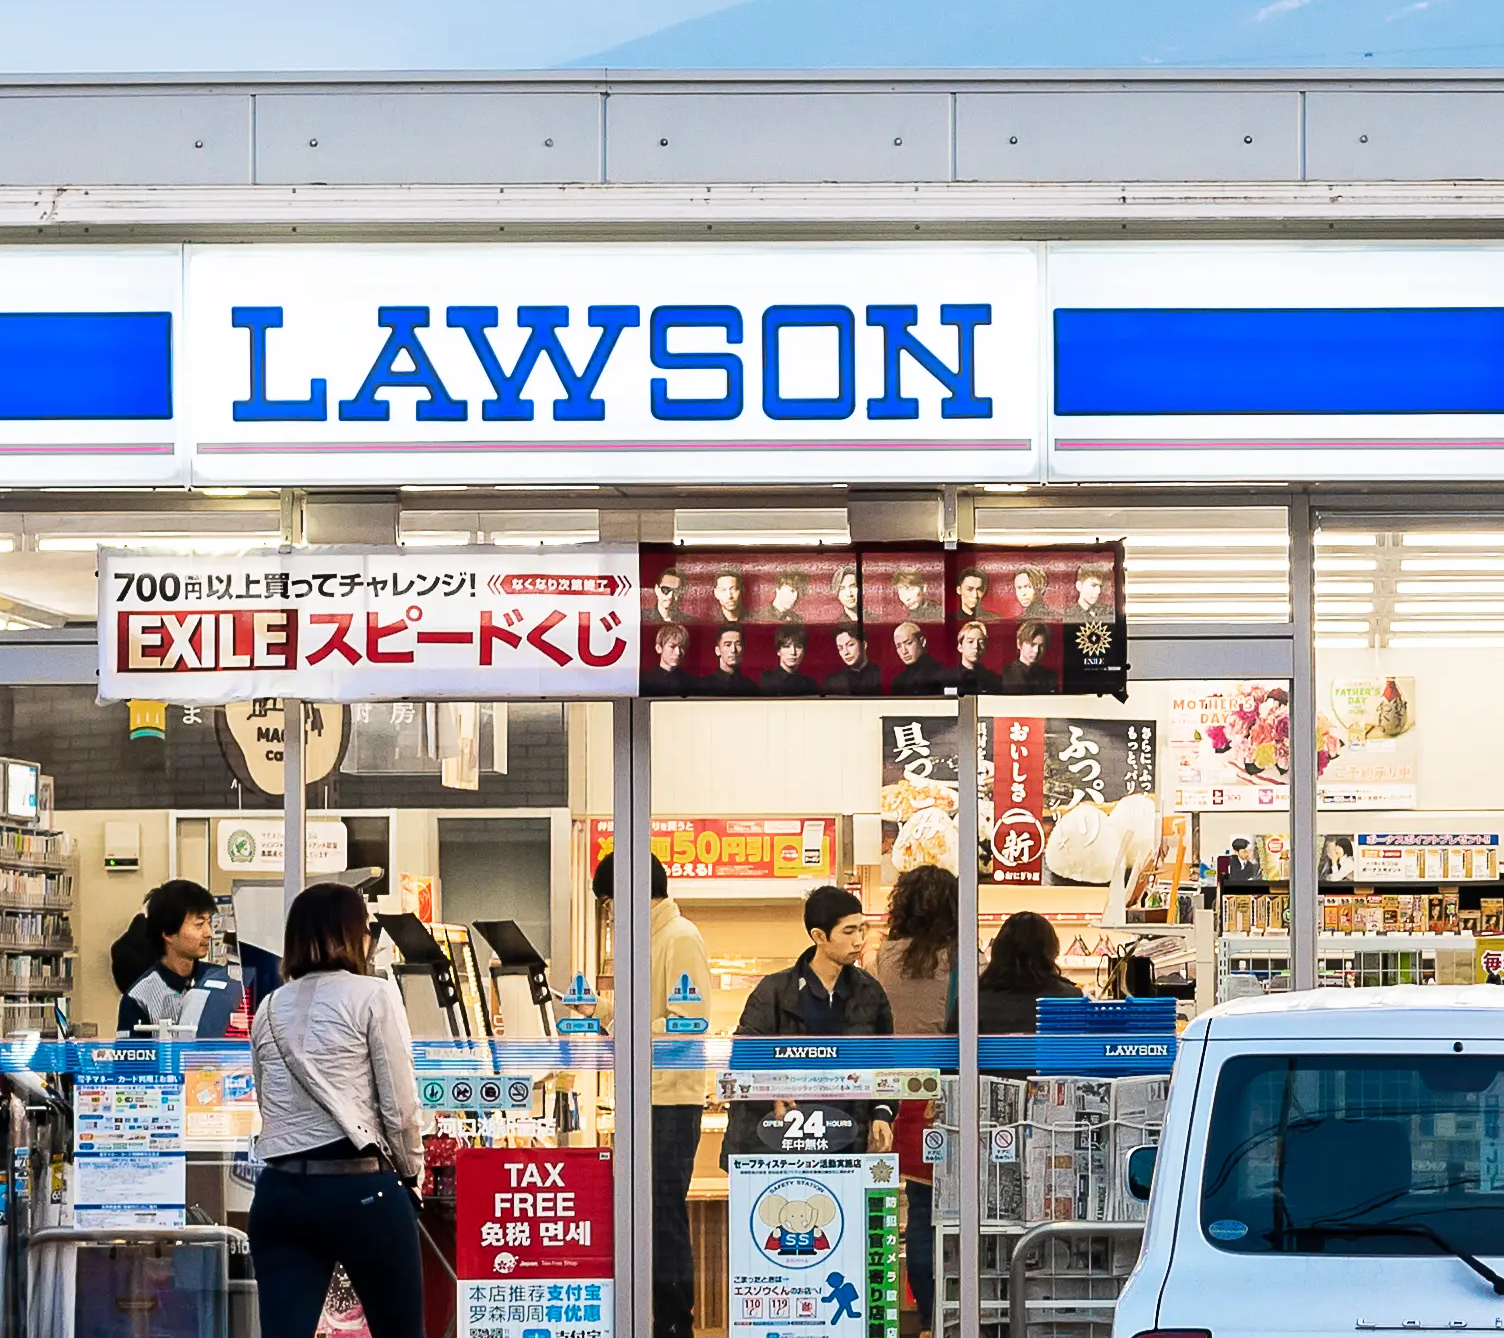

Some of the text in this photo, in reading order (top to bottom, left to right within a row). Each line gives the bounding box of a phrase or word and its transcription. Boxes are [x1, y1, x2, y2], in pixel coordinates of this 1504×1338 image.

[230, 303, 994, 423] LAWSON
[127, 613, 288, 669] EXILE
[304, 605, 628, 667] スピードくじ
[1347, 696, 1368, 705] DAY
[1199, 712, 1231, 725] DAY
[1009, 721, 1030, 803] おいしさ
[774, 1046, 837, 1058] LAWSON
[1105, 1044, 1168, 1056] LAWSON
[762, 1120, 784, 1128] OPEN
[783, 1109, 826, 1138] 24
[781, 1138, 829, 1151] 年中無休
[504, 1162, 566, 1188] TAX
[769, 1180, 825, 1194] SAFETY STATION
[494, 1192, 576, 1218] FREE
[480, 1220, 593, 1247] 免税 면세
[469, 1284, 602, 1302] 本店推荐支付宝
[469, 1304, 602, 1323] 罗森周周有优惠
[771, 1299, 788, 1309] 119
